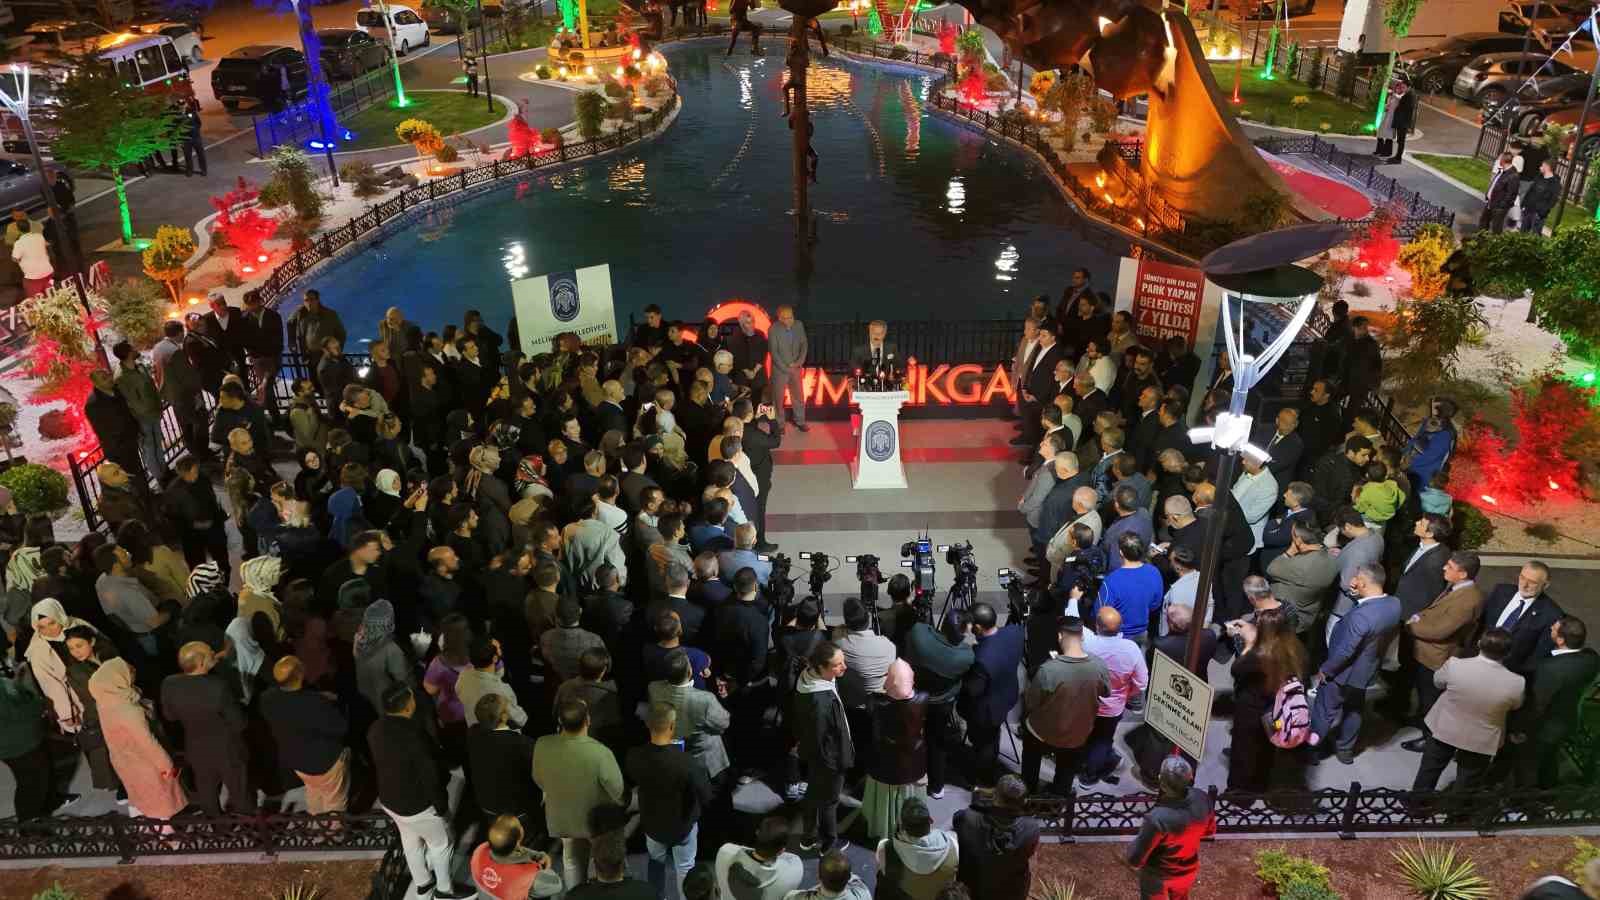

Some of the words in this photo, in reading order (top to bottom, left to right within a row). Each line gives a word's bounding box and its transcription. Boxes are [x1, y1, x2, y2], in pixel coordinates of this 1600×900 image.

[1141, 282, 1165, 296] PARK
[1167, 287, 1197, 301] YAPAN
[1139, 296, 1194, 316] BELEDİYESİ
[1139, 309, 1147, 322] 7
[1152, 311, 1191, 330] YILDA
